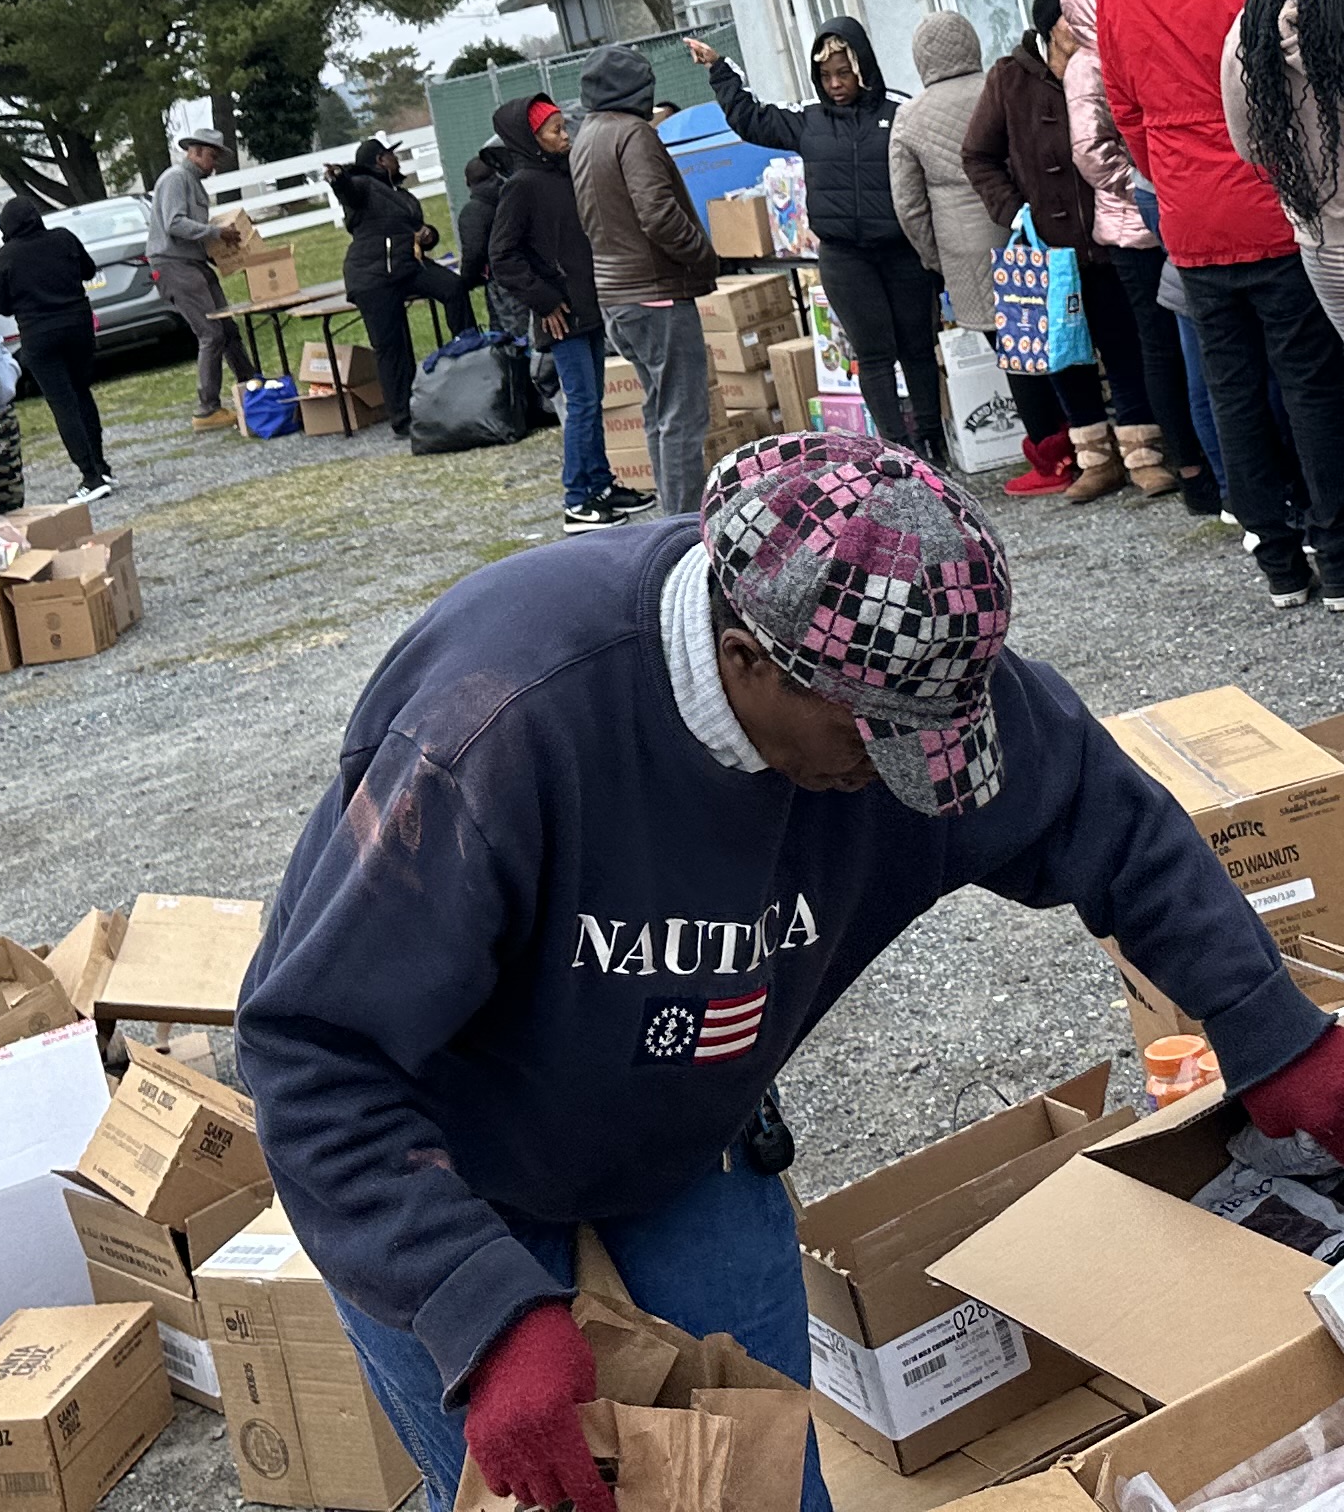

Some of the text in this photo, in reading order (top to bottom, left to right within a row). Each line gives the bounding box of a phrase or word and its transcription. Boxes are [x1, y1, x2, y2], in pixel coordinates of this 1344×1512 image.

[1210, 820, 1267, 850] PACIFIC
[1243, 844, 1299, 874] WALNUTS
[572, 893, 820, 976] NAUTICA
[199, 1138, 228, 1159] CRUZ
[204, 1121, 234, 1148] SANTA
[11, 1346, 55, 1377] CRUZ
[58, 1398, 81, 1431] SANTA
